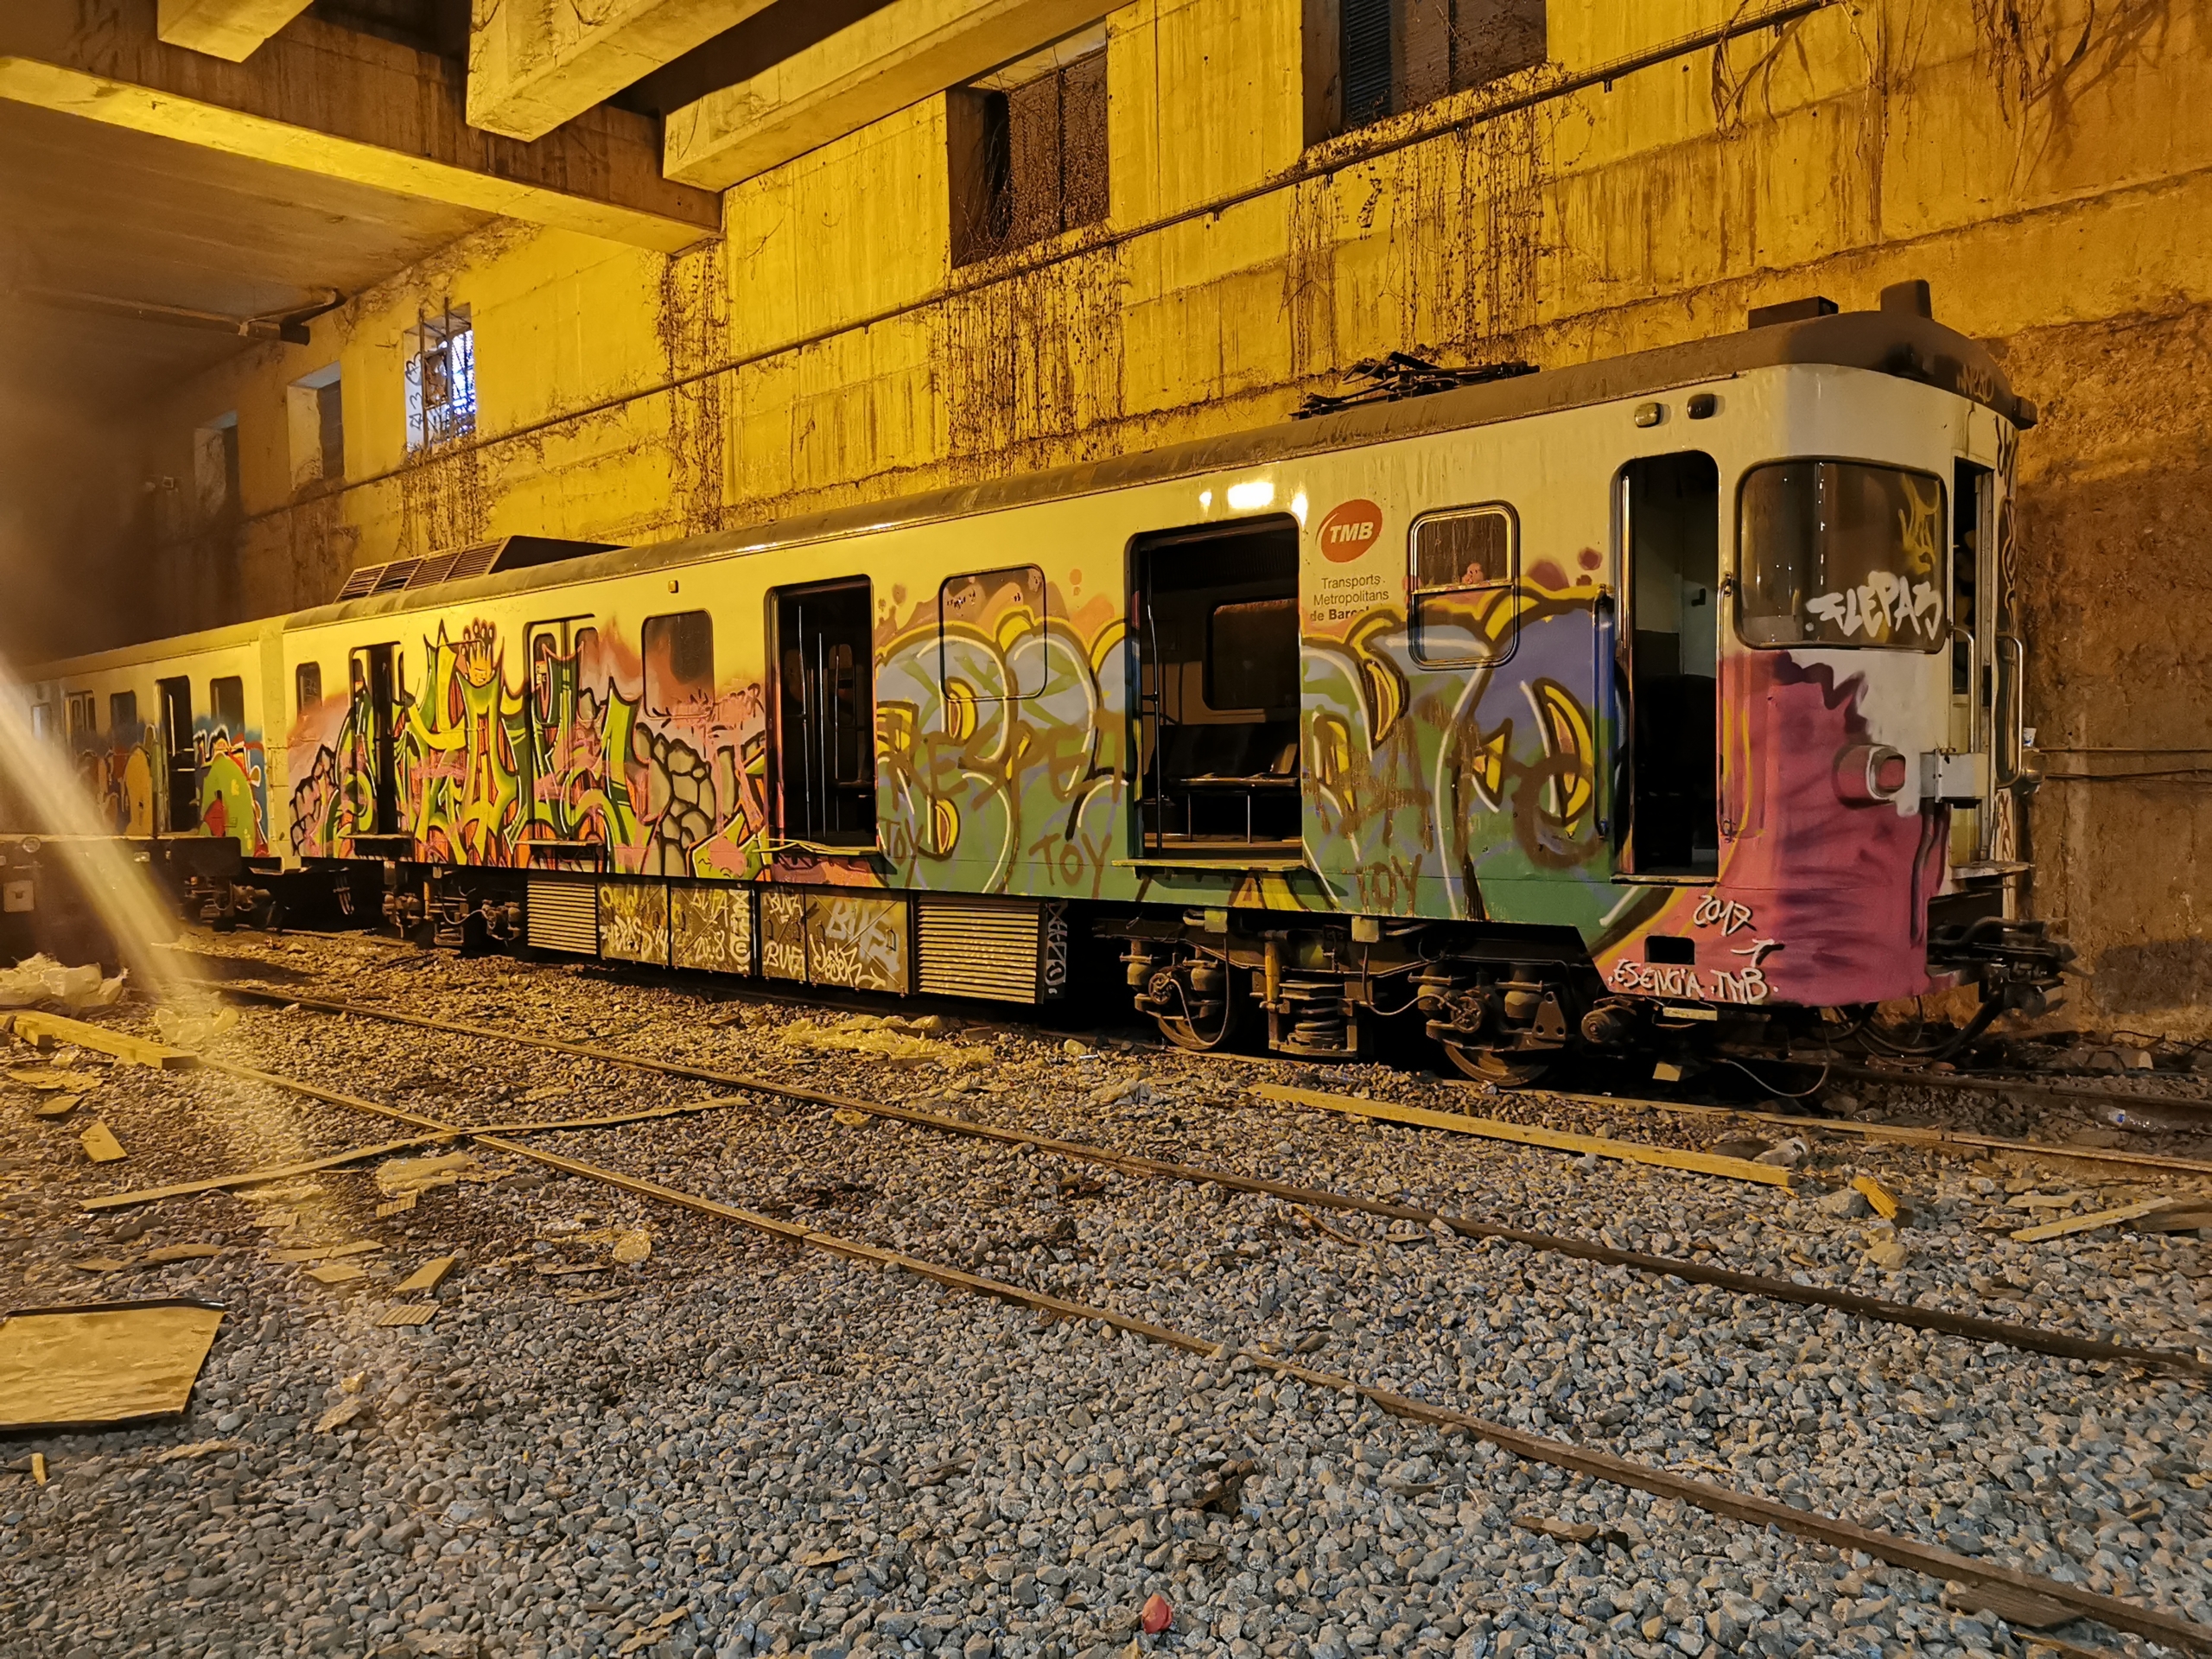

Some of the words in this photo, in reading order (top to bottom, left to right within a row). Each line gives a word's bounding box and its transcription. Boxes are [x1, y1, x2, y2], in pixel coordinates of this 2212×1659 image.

[1329, 520, 1374, 544] TMB
[1321, 574, 1381, 589] Transports
[1313, 590, 1389, 606] Metropolitans
[1311, 610, 1324, 622] de
[1028, 832, 1112, 900] TOY
[1694, 894, 1751, 936] 2017
